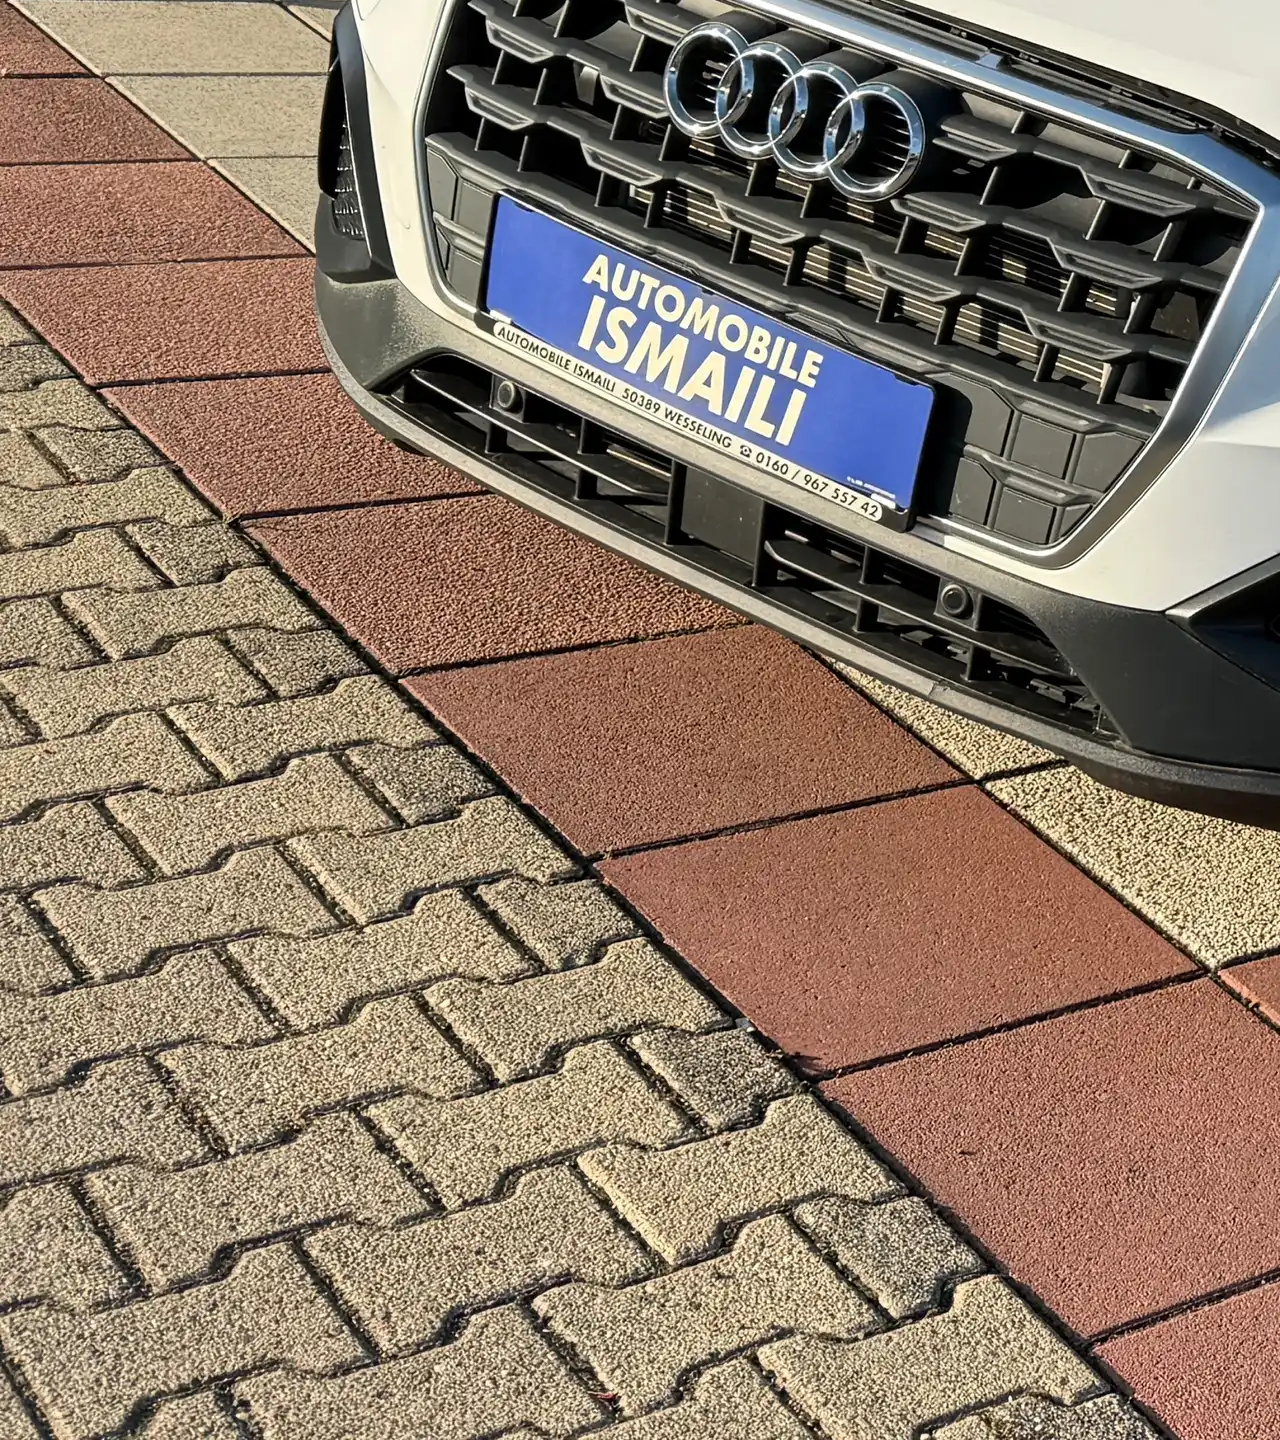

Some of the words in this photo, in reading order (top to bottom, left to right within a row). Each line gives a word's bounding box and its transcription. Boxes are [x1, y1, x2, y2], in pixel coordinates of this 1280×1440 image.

[577, 294, 807, 447] ISMAILI
[582, 253, 825, 389] AUTOMOBILE
[497, 326, 571, 371] AUTOMOBILE
[573, 363, 616, 393] ISMAILI
[621, 387, 661, 414] 50389
[664, 406, 733, 449] WESSELING
[755, 451, 790, 476] 0160
[791, 469, 802, 481] /
[803, 474, 829, 493] 967
[831, 487, 858, 507] 557
[860, 501, 879, 518] 42
